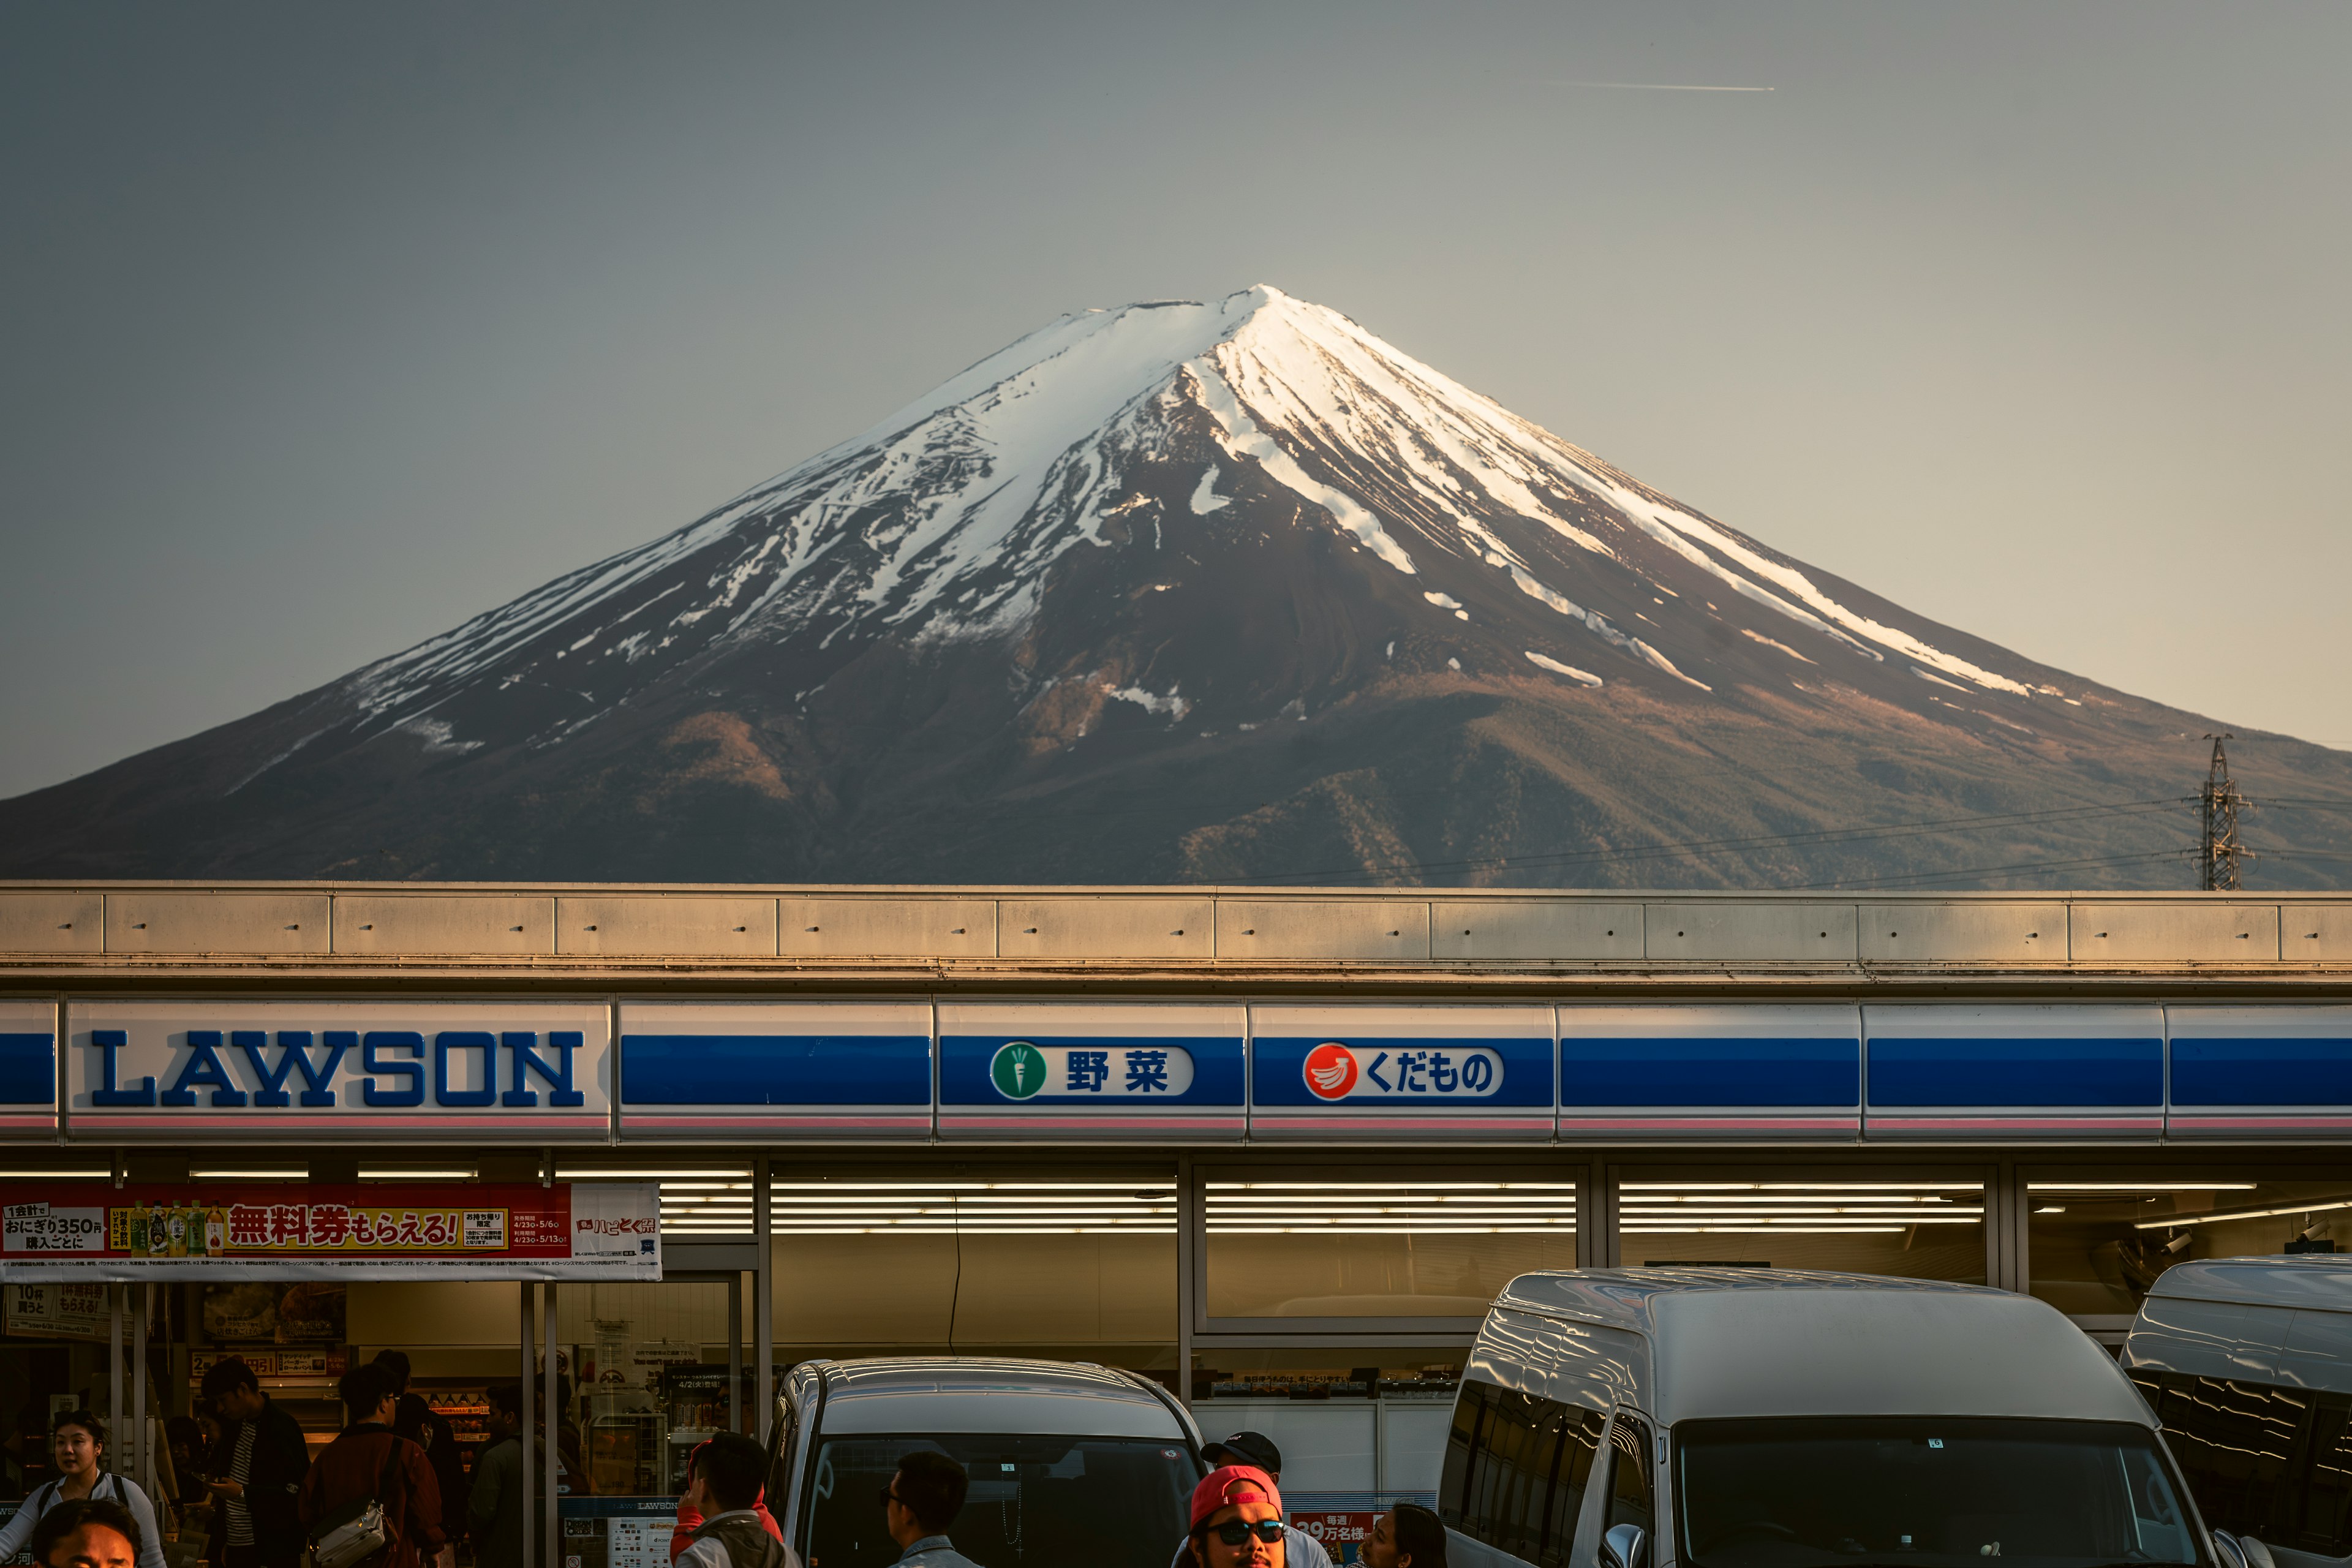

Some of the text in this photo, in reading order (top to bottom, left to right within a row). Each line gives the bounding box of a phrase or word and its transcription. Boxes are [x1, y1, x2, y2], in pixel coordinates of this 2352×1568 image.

[92, 1030, 585, 1106] LAWSON
[1067, 1050, 1168, 1093] 野菜
[1366, 1052, 1492, 1093] くだもの
[9, 1205, 45, 1217] 1会計で
[6, 1219, 102, 1234] おにぎり350円
[119, 1212, 128, 1246] 対象の飲料
[228, 1204, 458, 1245] 無料券もらえる!
[594, 1218, 655, 1235] ハピとく祭
[26, 1236, 83, 1250] 購入ごとに
[18, 1284, 44, 1301] 10杯
[61, 1284, 104, 1299] 1杯無料券
[18, 1300, 44, 1314] 買うと
[59, 1297, 98, 1313] もらえる!
[1327, 1515, 1347, 1525] 毎週
